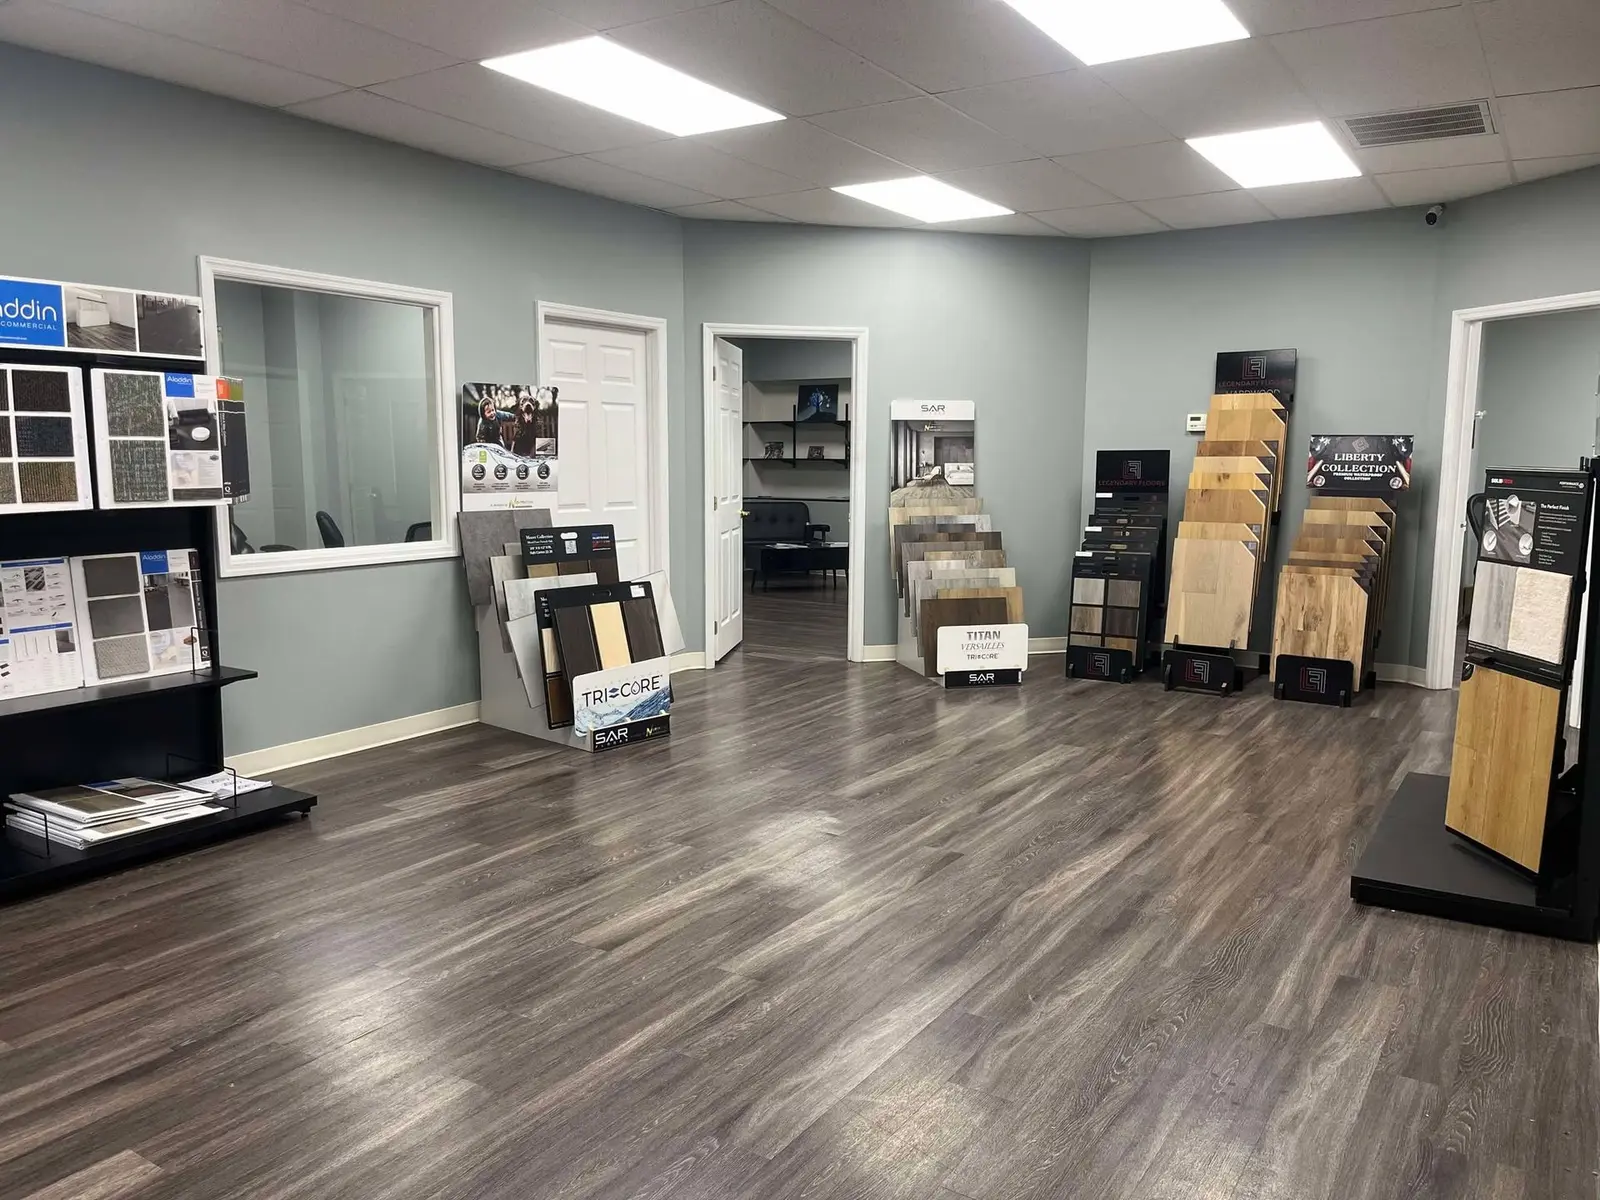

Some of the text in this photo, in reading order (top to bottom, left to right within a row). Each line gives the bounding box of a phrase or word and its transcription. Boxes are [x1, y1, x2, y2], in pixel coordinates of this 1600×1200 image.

[0, 297, 57, 321] ddin
[0, 320, 57, 330] COMMERCIAL
[921, 404, 946, 412] SAR
[1334, 453, 1385, 462] LIBERTY
[1321, 464, 1397, 473] COLLECTION
[967, 630, 1001, 641] TITAN
[961, 642, 1005, 651] VERSAILLES
[968, 673, 995, 682] SAR
[595, 727, 628, 745] SAR
